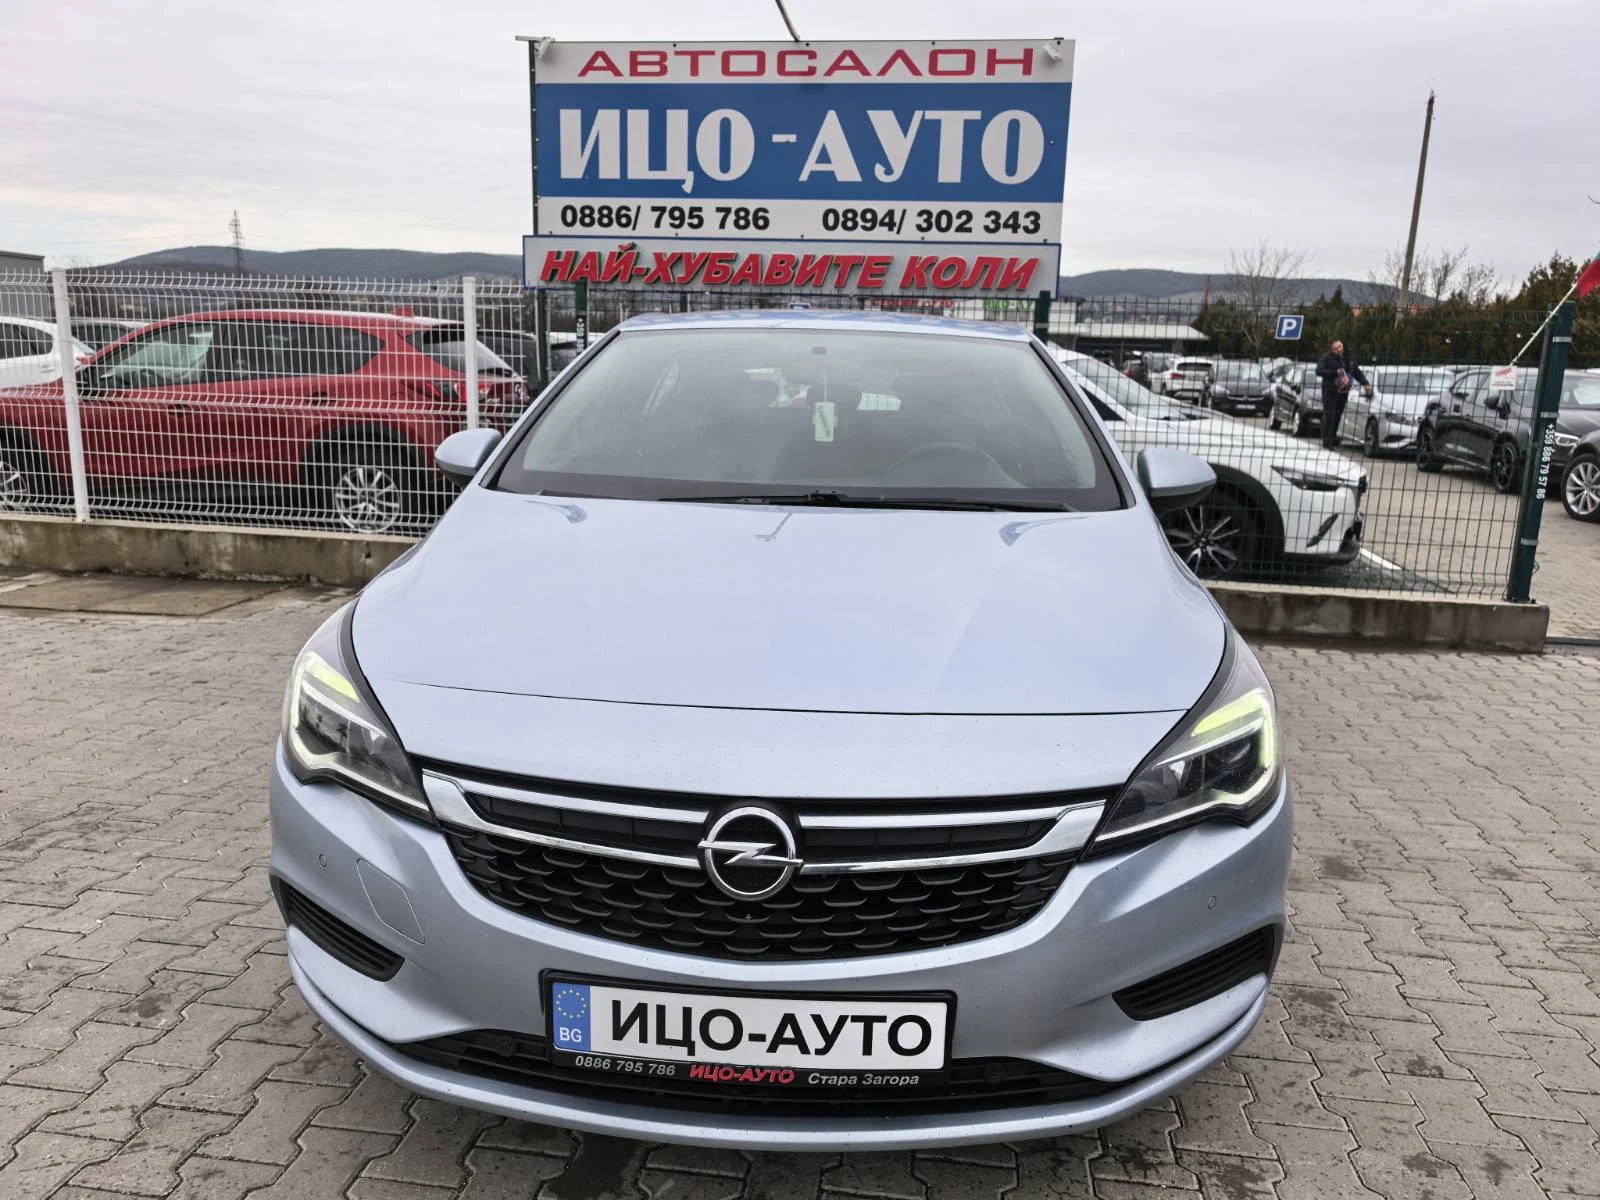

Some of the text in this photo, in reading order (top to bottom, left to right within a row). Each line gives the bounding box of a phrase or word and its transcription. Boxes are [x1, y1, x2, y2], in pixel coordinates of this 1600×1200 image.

[577, 48, 1033, 77] АВТОСАЛОН
[561, 205, 770, 231] 0886/ 795 786
[822, 208, 1041, 234] 0894/ 302 343
[539, 242, 1040, 291] НАЙ-ХУБАВИТЕ КОЛИ
[1281, 318, 1297, 337] P
[1536, 423, 1555, 500] +359 886 79 57 86
[559, 1027, 582, 1043] BG
[612, 999, 932, 1057] ИЦО-АУТО
[575, 1055, 676, 1076] 0886 795 786
[689, 1064, 795, 1083] ИЦО-АУТО
[808, 1072, 919, 1087] Стара Загора
